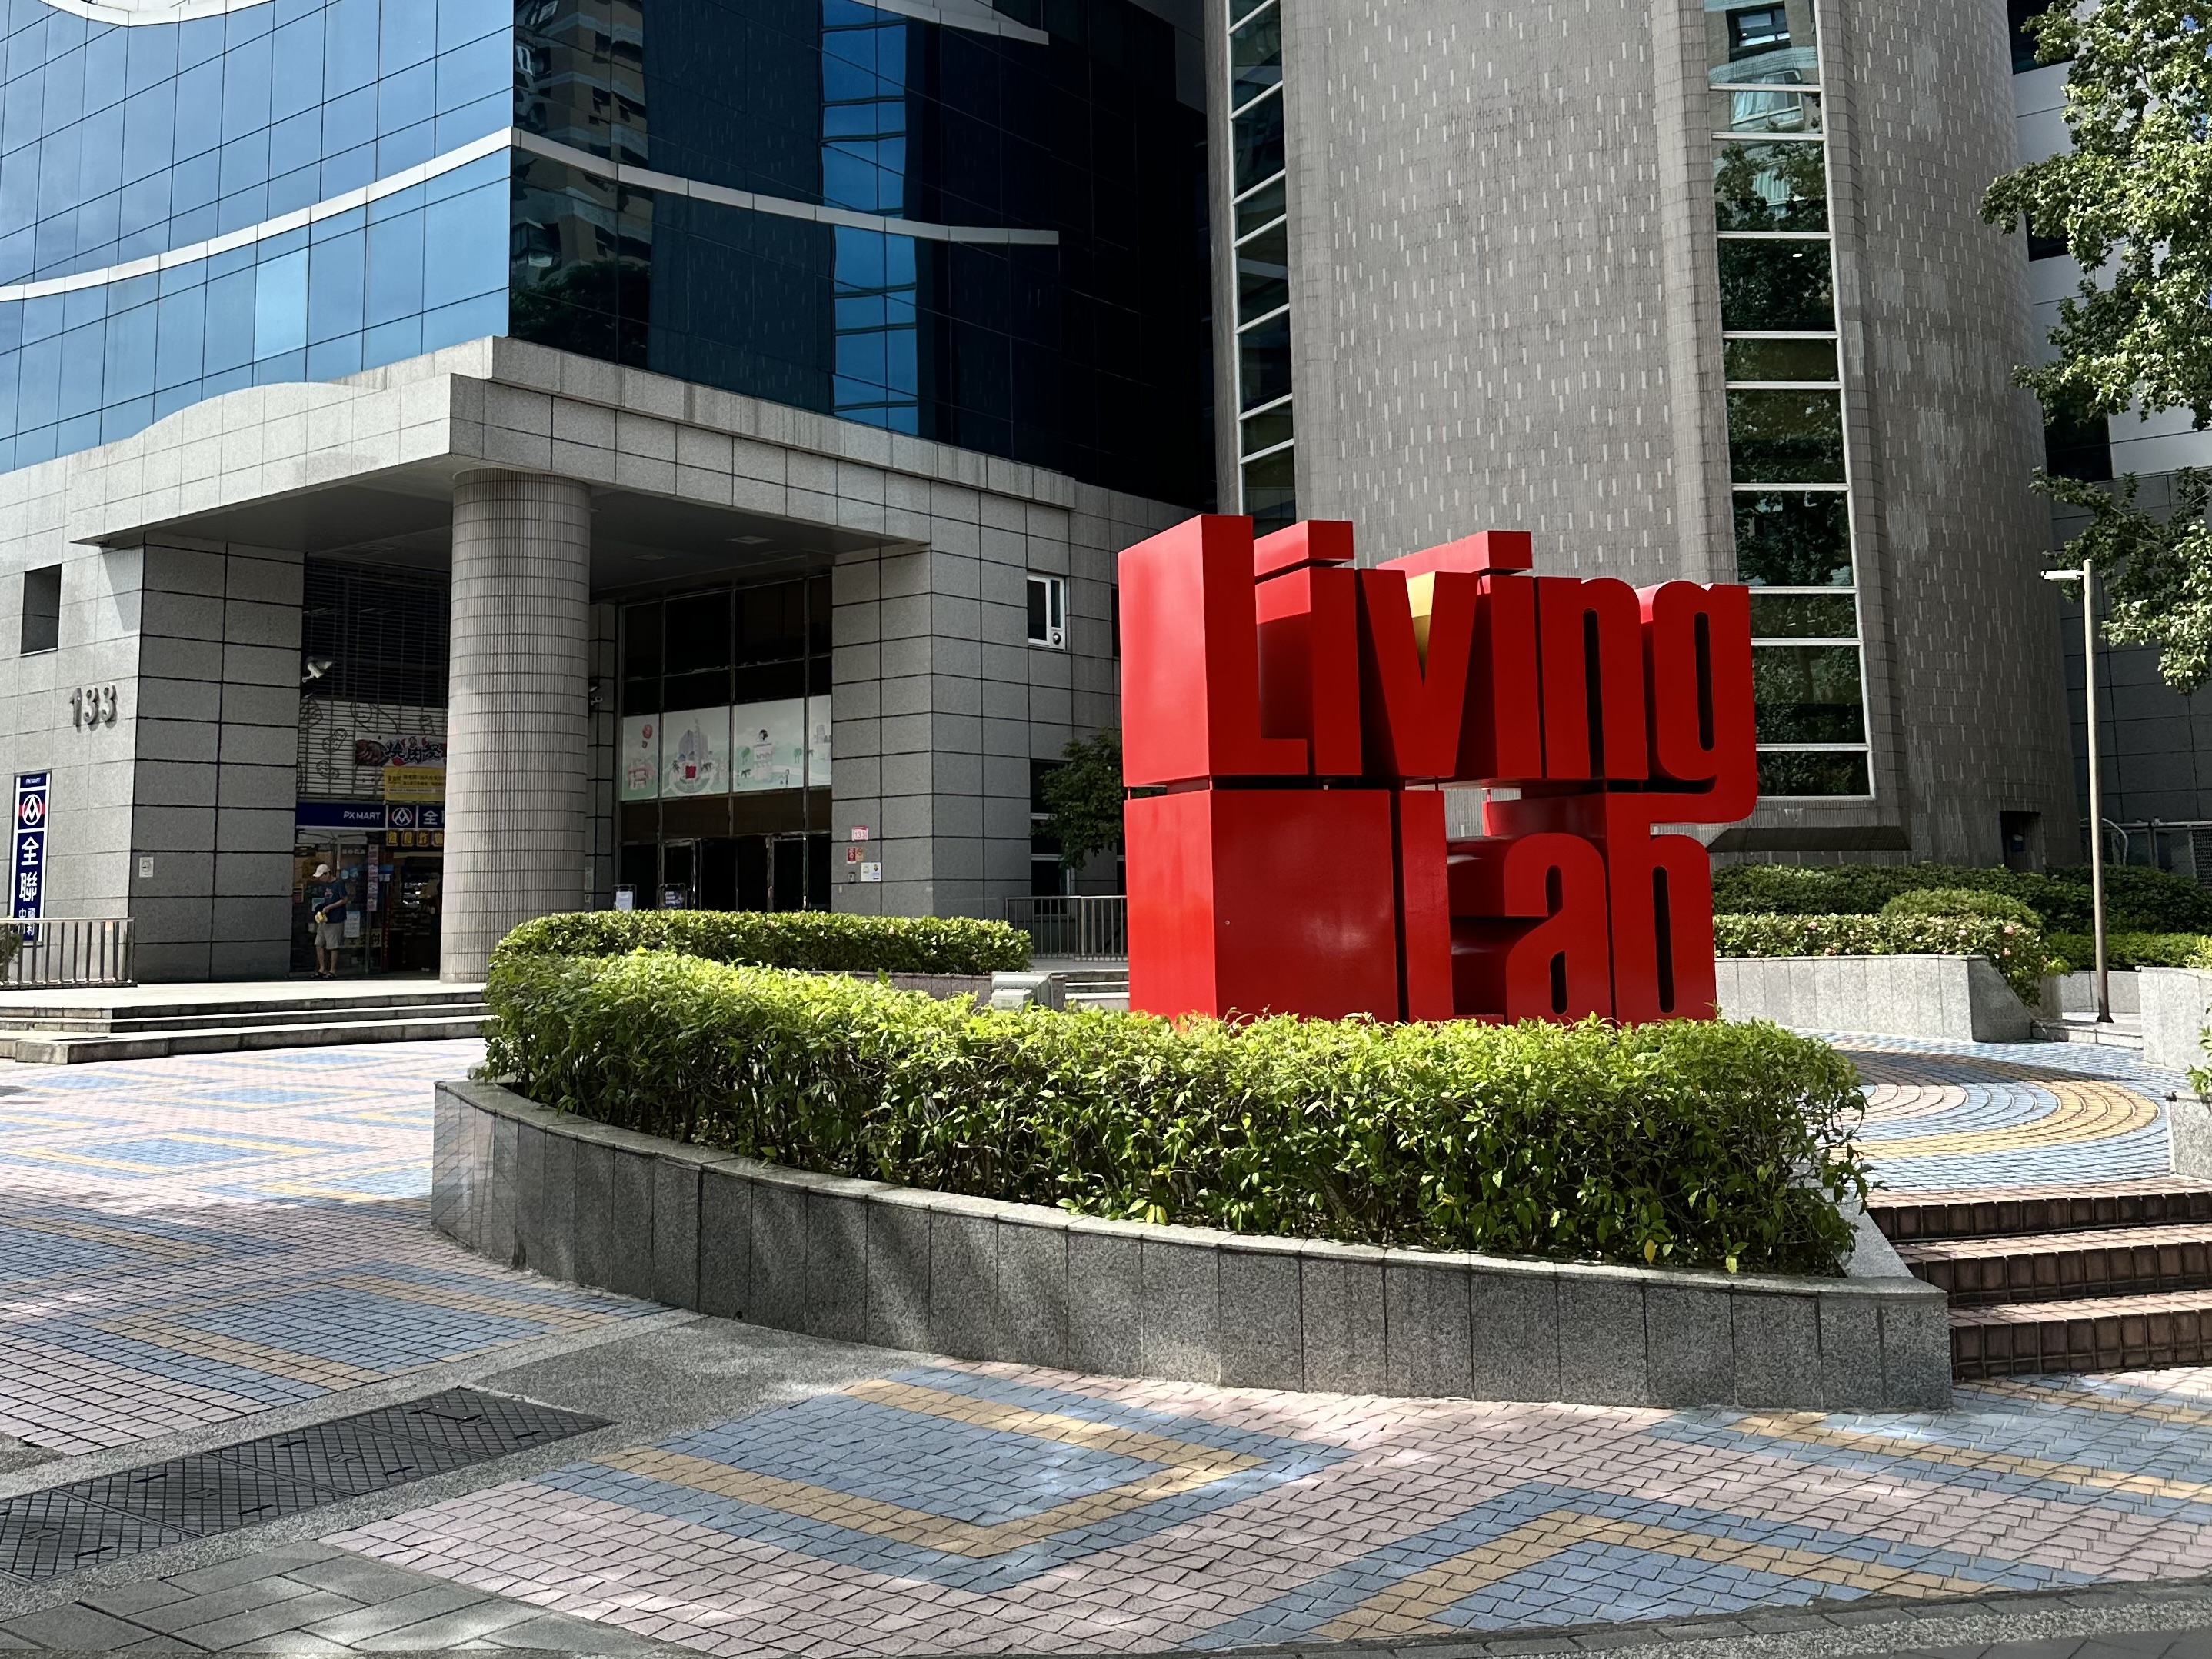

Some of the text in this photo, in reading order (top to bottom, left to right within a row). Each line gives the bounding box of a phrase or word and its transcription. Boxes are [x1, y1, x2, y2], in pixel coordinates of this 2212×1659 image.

[1201, 515, 1757, 823] Living
[69, 684, 117, 727] 133
[343, 811, 381, 821] PX MART
[422, 810, 445, 825] 全
[19, 836, 39, 902] 全聯
[1401, 791, 1717, 1024] Lab
